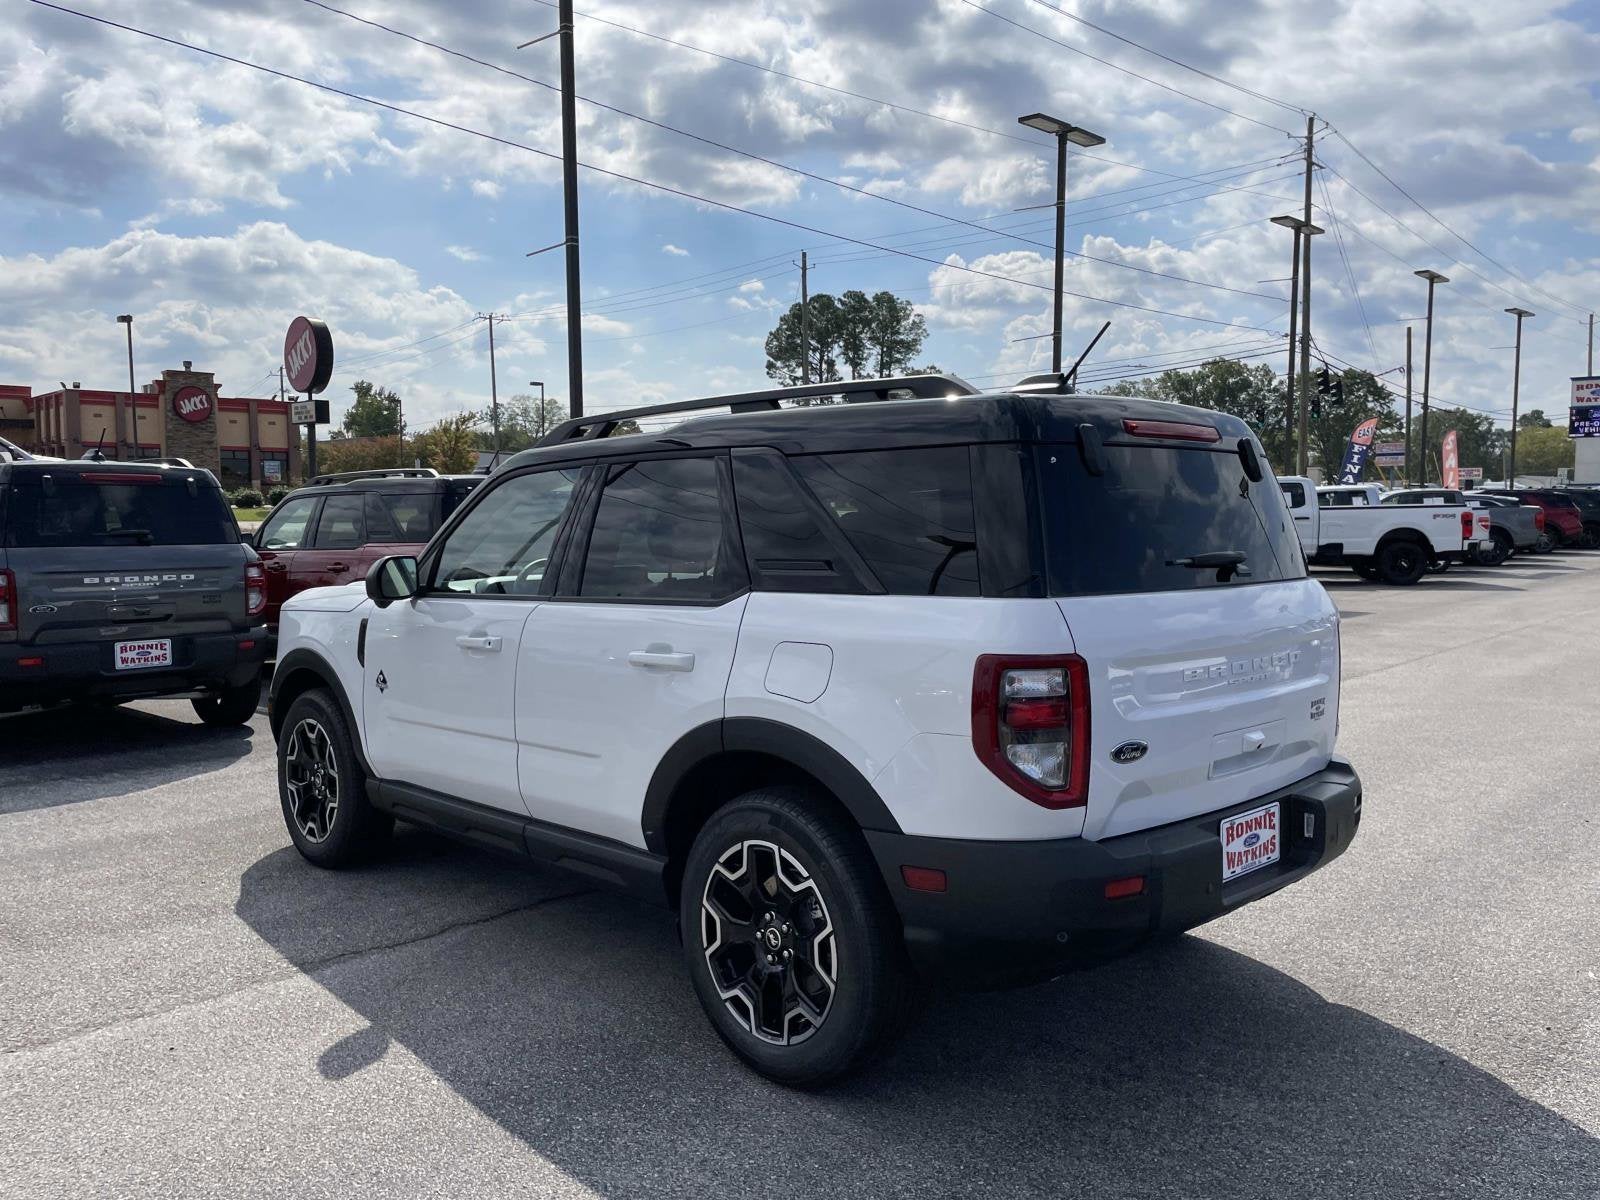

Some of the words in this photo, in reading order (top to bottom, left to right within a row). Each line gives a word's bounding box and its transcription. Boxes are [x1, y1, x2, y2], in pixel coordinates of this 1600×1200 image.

[288, 330, 312, 379] JACK'S
[180, 394, 208, 414] JACK'S
[1358, 425, 1376, 438] EASY
[83, 574, 195, 584] BRONCO
[120, 643, 167, 654] RONNIE
[120, 653, 168, 665] WATKINS
[1183, 650, 1304, 682] BRONCO
[1120, 744, 1142, 760] Ford
[1226, 812, 1276, 847] RONNIE
[1226, 835, 1276, 870] WATKINS
